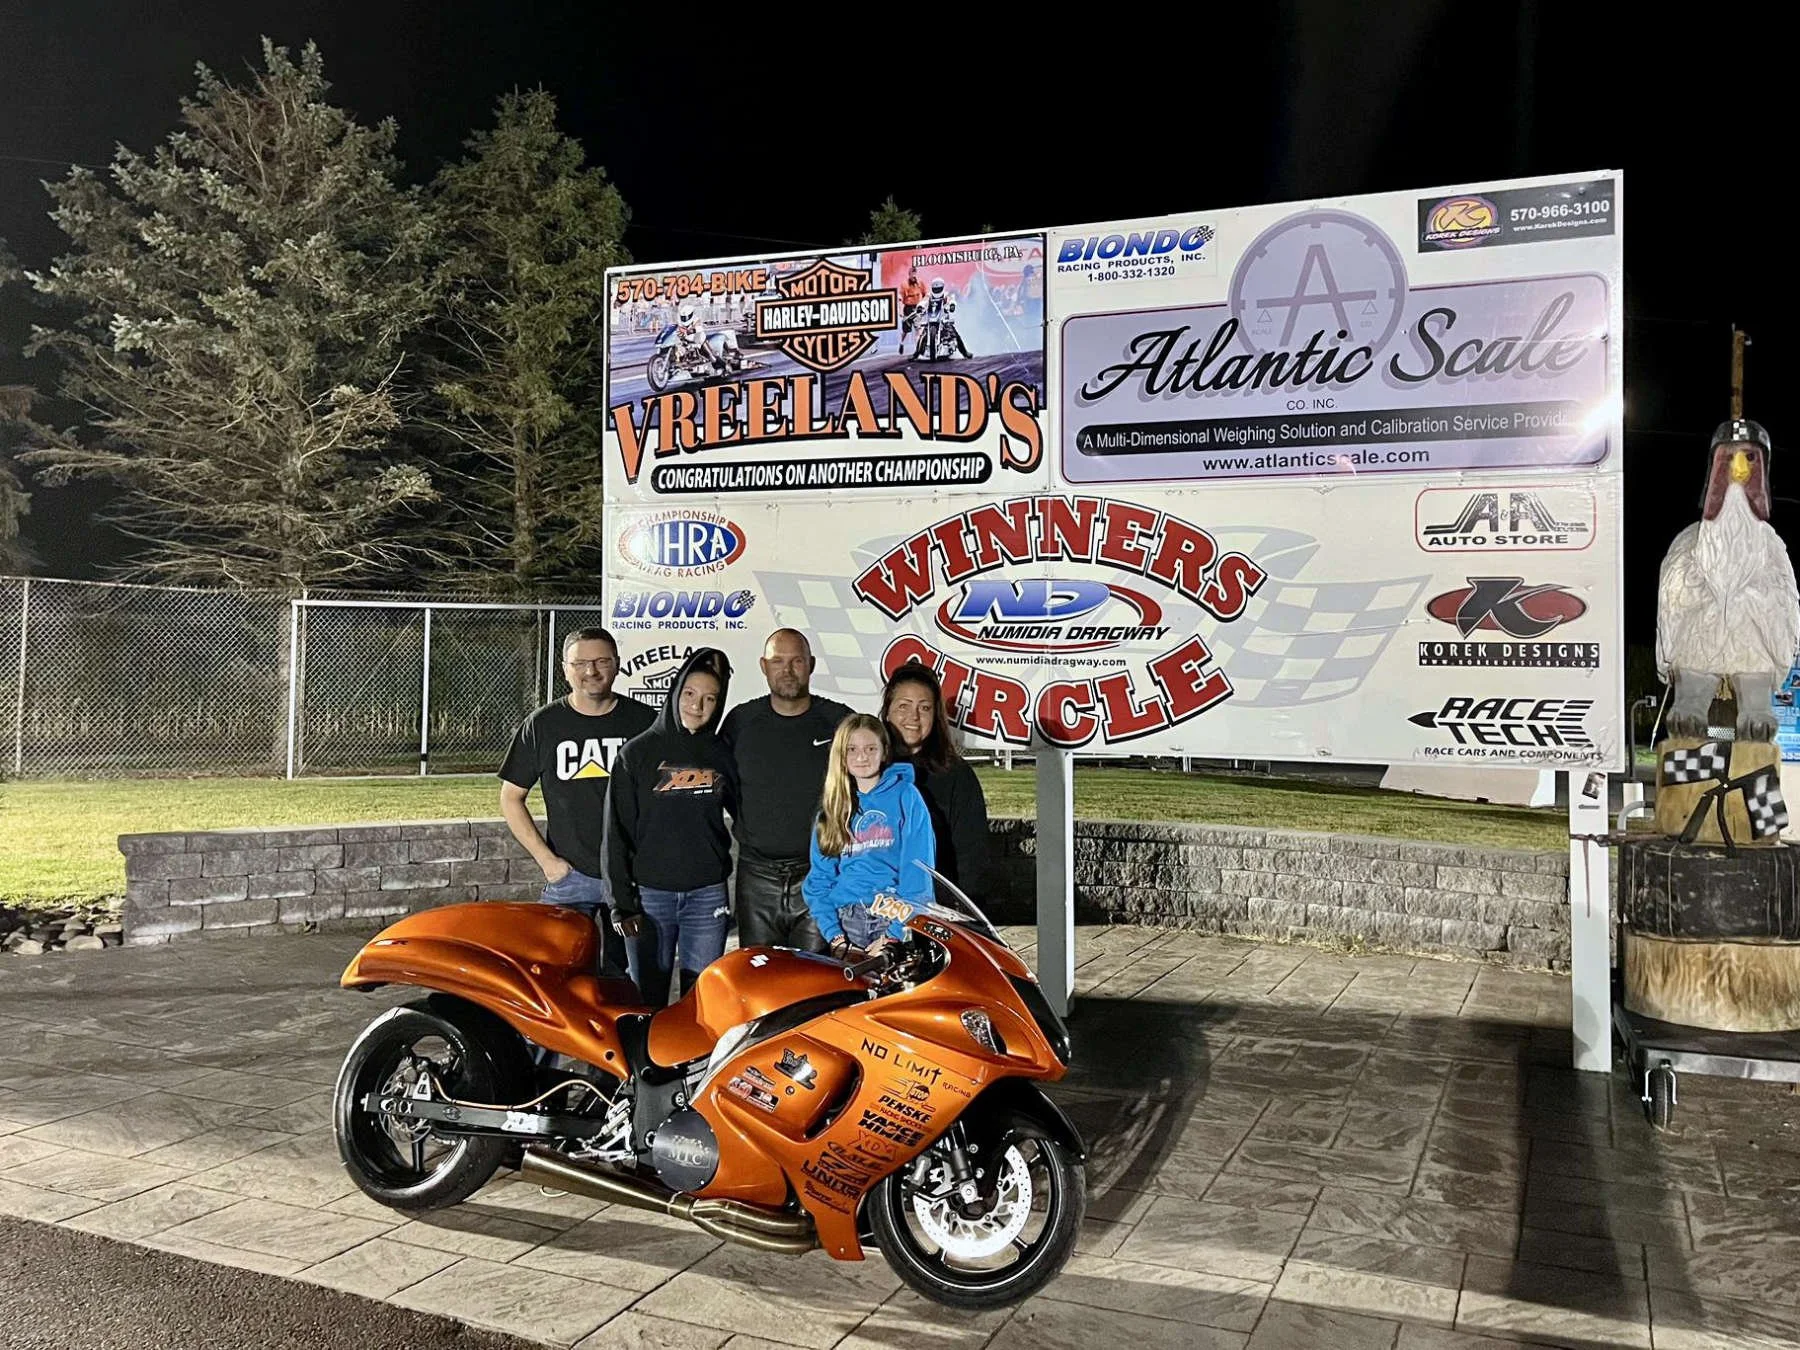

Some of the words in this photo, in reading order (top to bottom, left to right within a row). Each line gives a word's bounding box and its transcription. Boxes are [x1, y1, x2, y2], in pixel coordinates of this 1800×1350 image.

[1510, 200, 1610, 221] 570-966-3100
[1057, 226, 1206, 263] BIONDO
[1425, 231, 1457, 241] KOREK
[1457, 227, 1501, 237] DESIGNS
[911, 249, 1001, 268] BLOOMSBURG,
[1003, 246, 1023, 259] PA.
[1057, 263, 1101, 273] RACING
[1108, 256, 1174, 268] PRODUCTS,
[1181, 253, 1206, 261] INC.
[617, 268, 767, 304] 570-784-BIKE
[790, 269, 858, 297] MOTOR
[1088, 266, 1175, 282] 1-800-332-1320
[763, 298, 890, 331] HARLEY-DAVIDSON
[793, 332, 862, 364] CYCLES
[1081, 317, 1374, 401] Atlantic
[1390, 291, 1588, 383] Scale
[1286, 400, 1309, 410] CO.
[1313, 398, 1338, 408] INC.
[612, 370, 1043, 484] VREELAND'S
[1083, 437, 1094, 449] A
[1097, 428, 1211, 448] Multi-Dimensional
[1214, 424, 1277, 445] Weighing
[1280, 422, 1336, 440] Solution
[1340, 421, 1367, 437] and
[1370, 416, 1449, 435] Calibration
[1453, 413, 1509, 432] Service
[1513, 410, 1578, 428] Provid
[658, 464, 783, 489] CONGRATULATIONS
[785, 464, 806, 485] ON
[807, 461, 873, 484] ANOTHER
[875, 456, 985, 482] CHAMPIONSHIP
[1203, 448, 1430, 471] www.atlanticscale.com
[638, 509, 727, 529] CHAMPIONSHIP
[642, 522, 728, 565] NHRA
[1428, 536, 1487, 546] AUTO
[1494, 533, 1569, 545] STORE
[677, 560, 726, 578] RACING
[851, 494, 1268, 622] WINNERS
[611, 590, 756, 618] BIONDO
[612, 621, 652, 630] RACING
[658, 621, 719, 631] PRODUCTS,
[725, 621, 748, 630] INC.
[977, 625, 1063, 641] NUMIDIA
[1064, 626, 1170, 642] DRAGWAY
[619, 644, 692, 678] VREELA
[976, 656, 1127, 668] www.numidiadragway.com
[1420, 643, 1487, 658] KOREK
[1503, 643, 1599, 658] DESIGNS
[880, 633, 1236, 750] CIRCLE
[1437, 698, 1566, 721] RACE
[1437, 721, 1566, 747] TECH
[557, 737, 623, 780] CAT
[1424, 747, 1454, 757] RACE
[1457, 749, 1487, 757] CARS
[1490, 749, 1516, 757] AND
[1519, 750, 1602, 762] COMPONENTS
[861, 1037, 888, 1060] NO
[894, 1054, 942, 1085] LIMIT
[942, 1081, 971, 1098] RACING
[878, 1095, 932, 1124] PENSKE
[863, 1109, 925, 1139] VANCE
